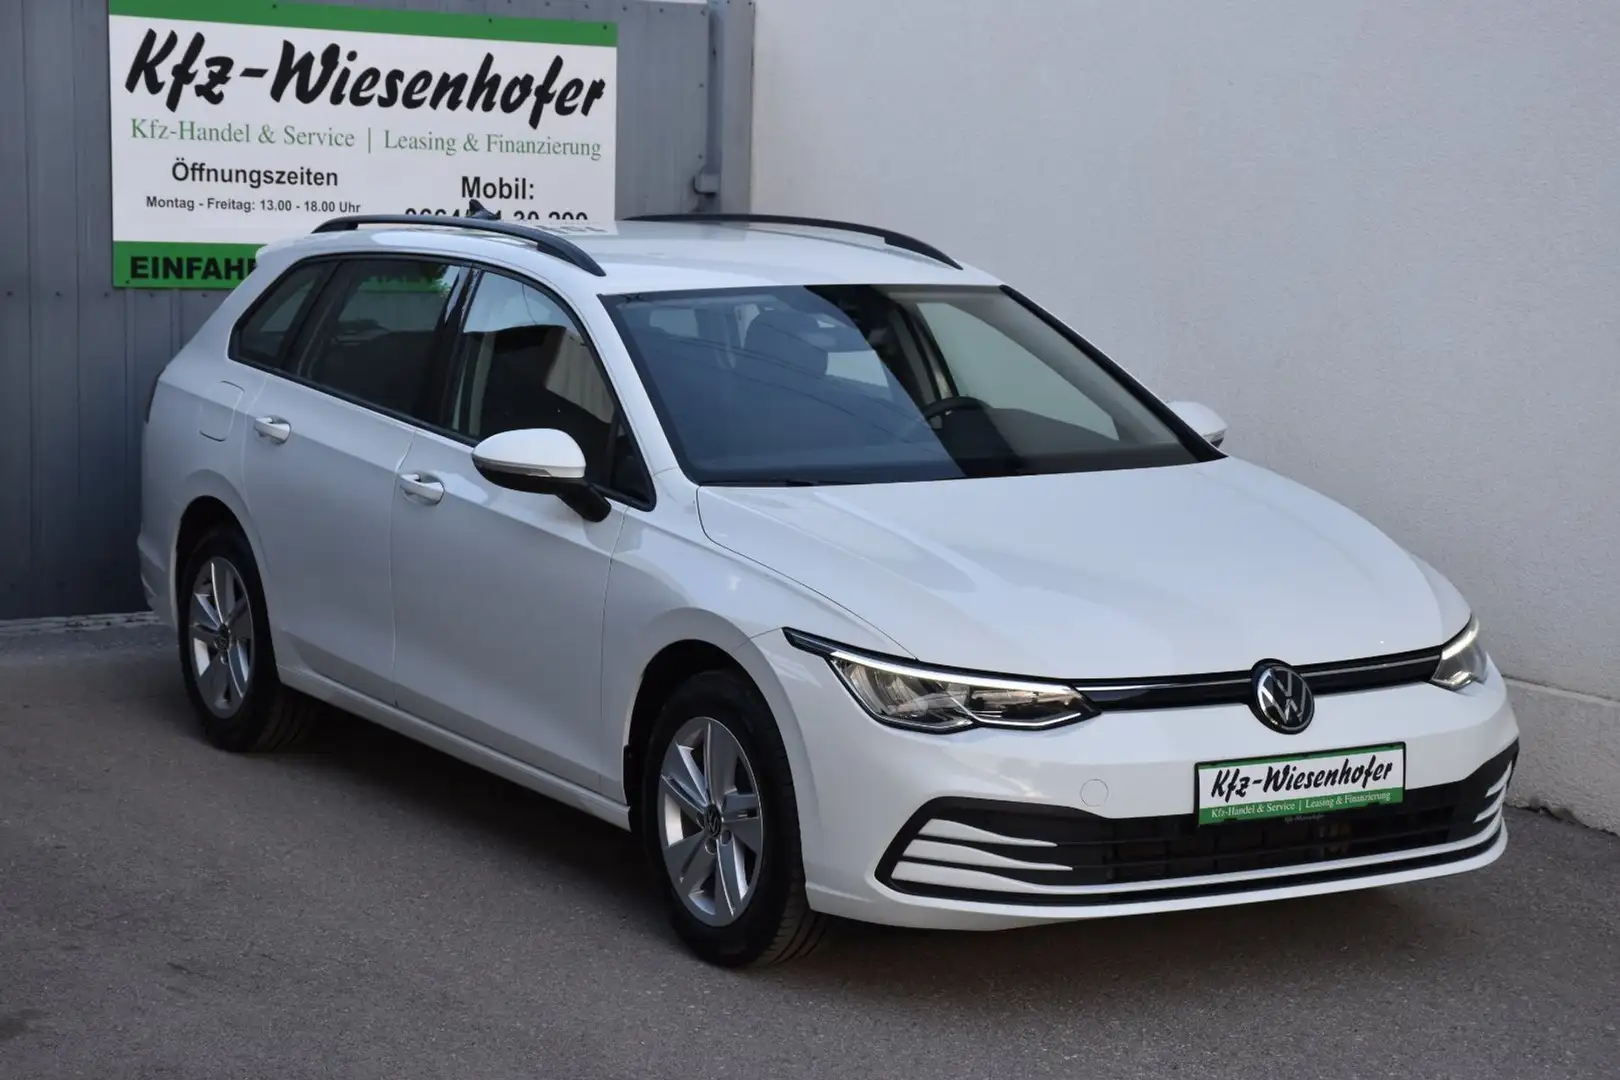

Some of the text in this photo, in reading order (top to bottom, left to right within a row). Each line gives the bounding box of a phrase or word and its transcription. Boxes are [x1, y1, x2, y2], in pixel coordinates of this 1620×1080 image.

[125, 28, 605, 129] Kfz-Wiesenhofer
[131, 118, 250, 143] Kfz-Handel
[258, 124, 276, 144] &
[283, 125, 355, 147] Service
[384, 129, 457, 156] Leasing
[463, 132, 479, 152] &
[486, 133, 602, 161] Finanzierung
[171, 157, 339, 189] Öffnungszeiten
[461, 176, 534, 200] Mobil:
[146, 196, 195, 211] Montag
[207, 198, 256, 213] Freitag:
[261, 200, 292, 212] 13.00
[305, 201, 336, 213] 18.00
[339, 202, 361, 214] Uhr
[130, 256, 257, 280] EINFAH
[1211, 755, 1393, 802] Kfz-Wiesenhofer
[1211, 803, 1256, 818] Kfz-Handel
[1257, 805, 1264, 814] &
[1266, 801, 1296, 812] Service
[1305, 796, 1334, 809] Leasing
[1336, 796, 1343, 805] &
[1344, 791, 1391, 805] Finanzierung
